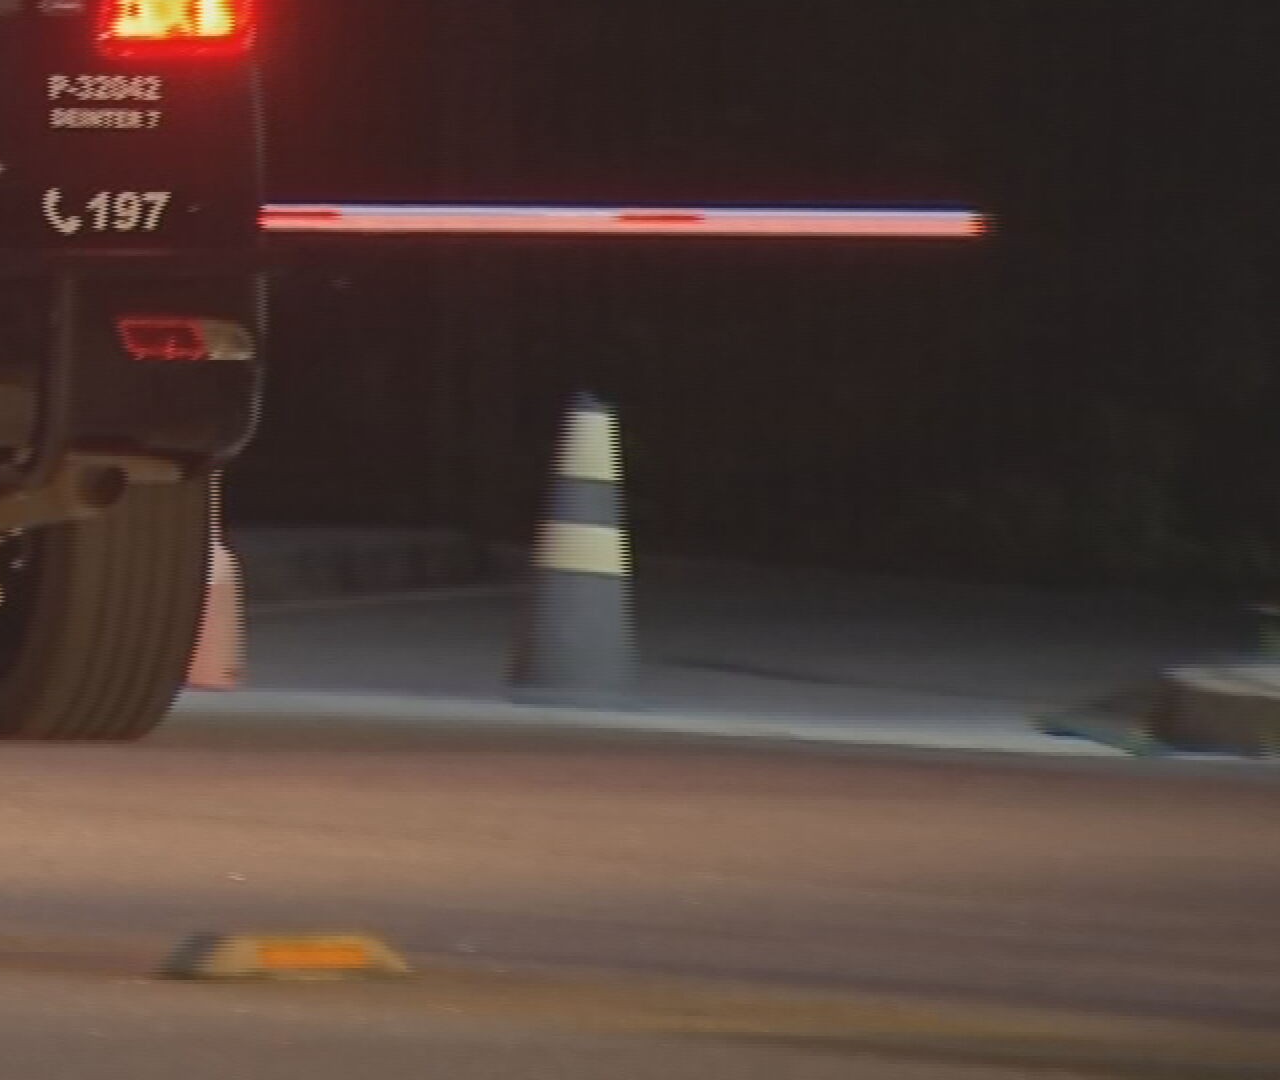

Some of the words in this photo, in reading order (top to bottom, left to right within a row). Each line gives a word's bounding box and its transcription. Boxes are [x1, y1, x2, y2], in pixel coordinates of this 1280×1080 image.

[47, 75, 162, 100] P-32042
[49, 108, 142, 128] DEINTER
[146, 111, 161, 128] 7
[86, 191, 172, 231] 197
